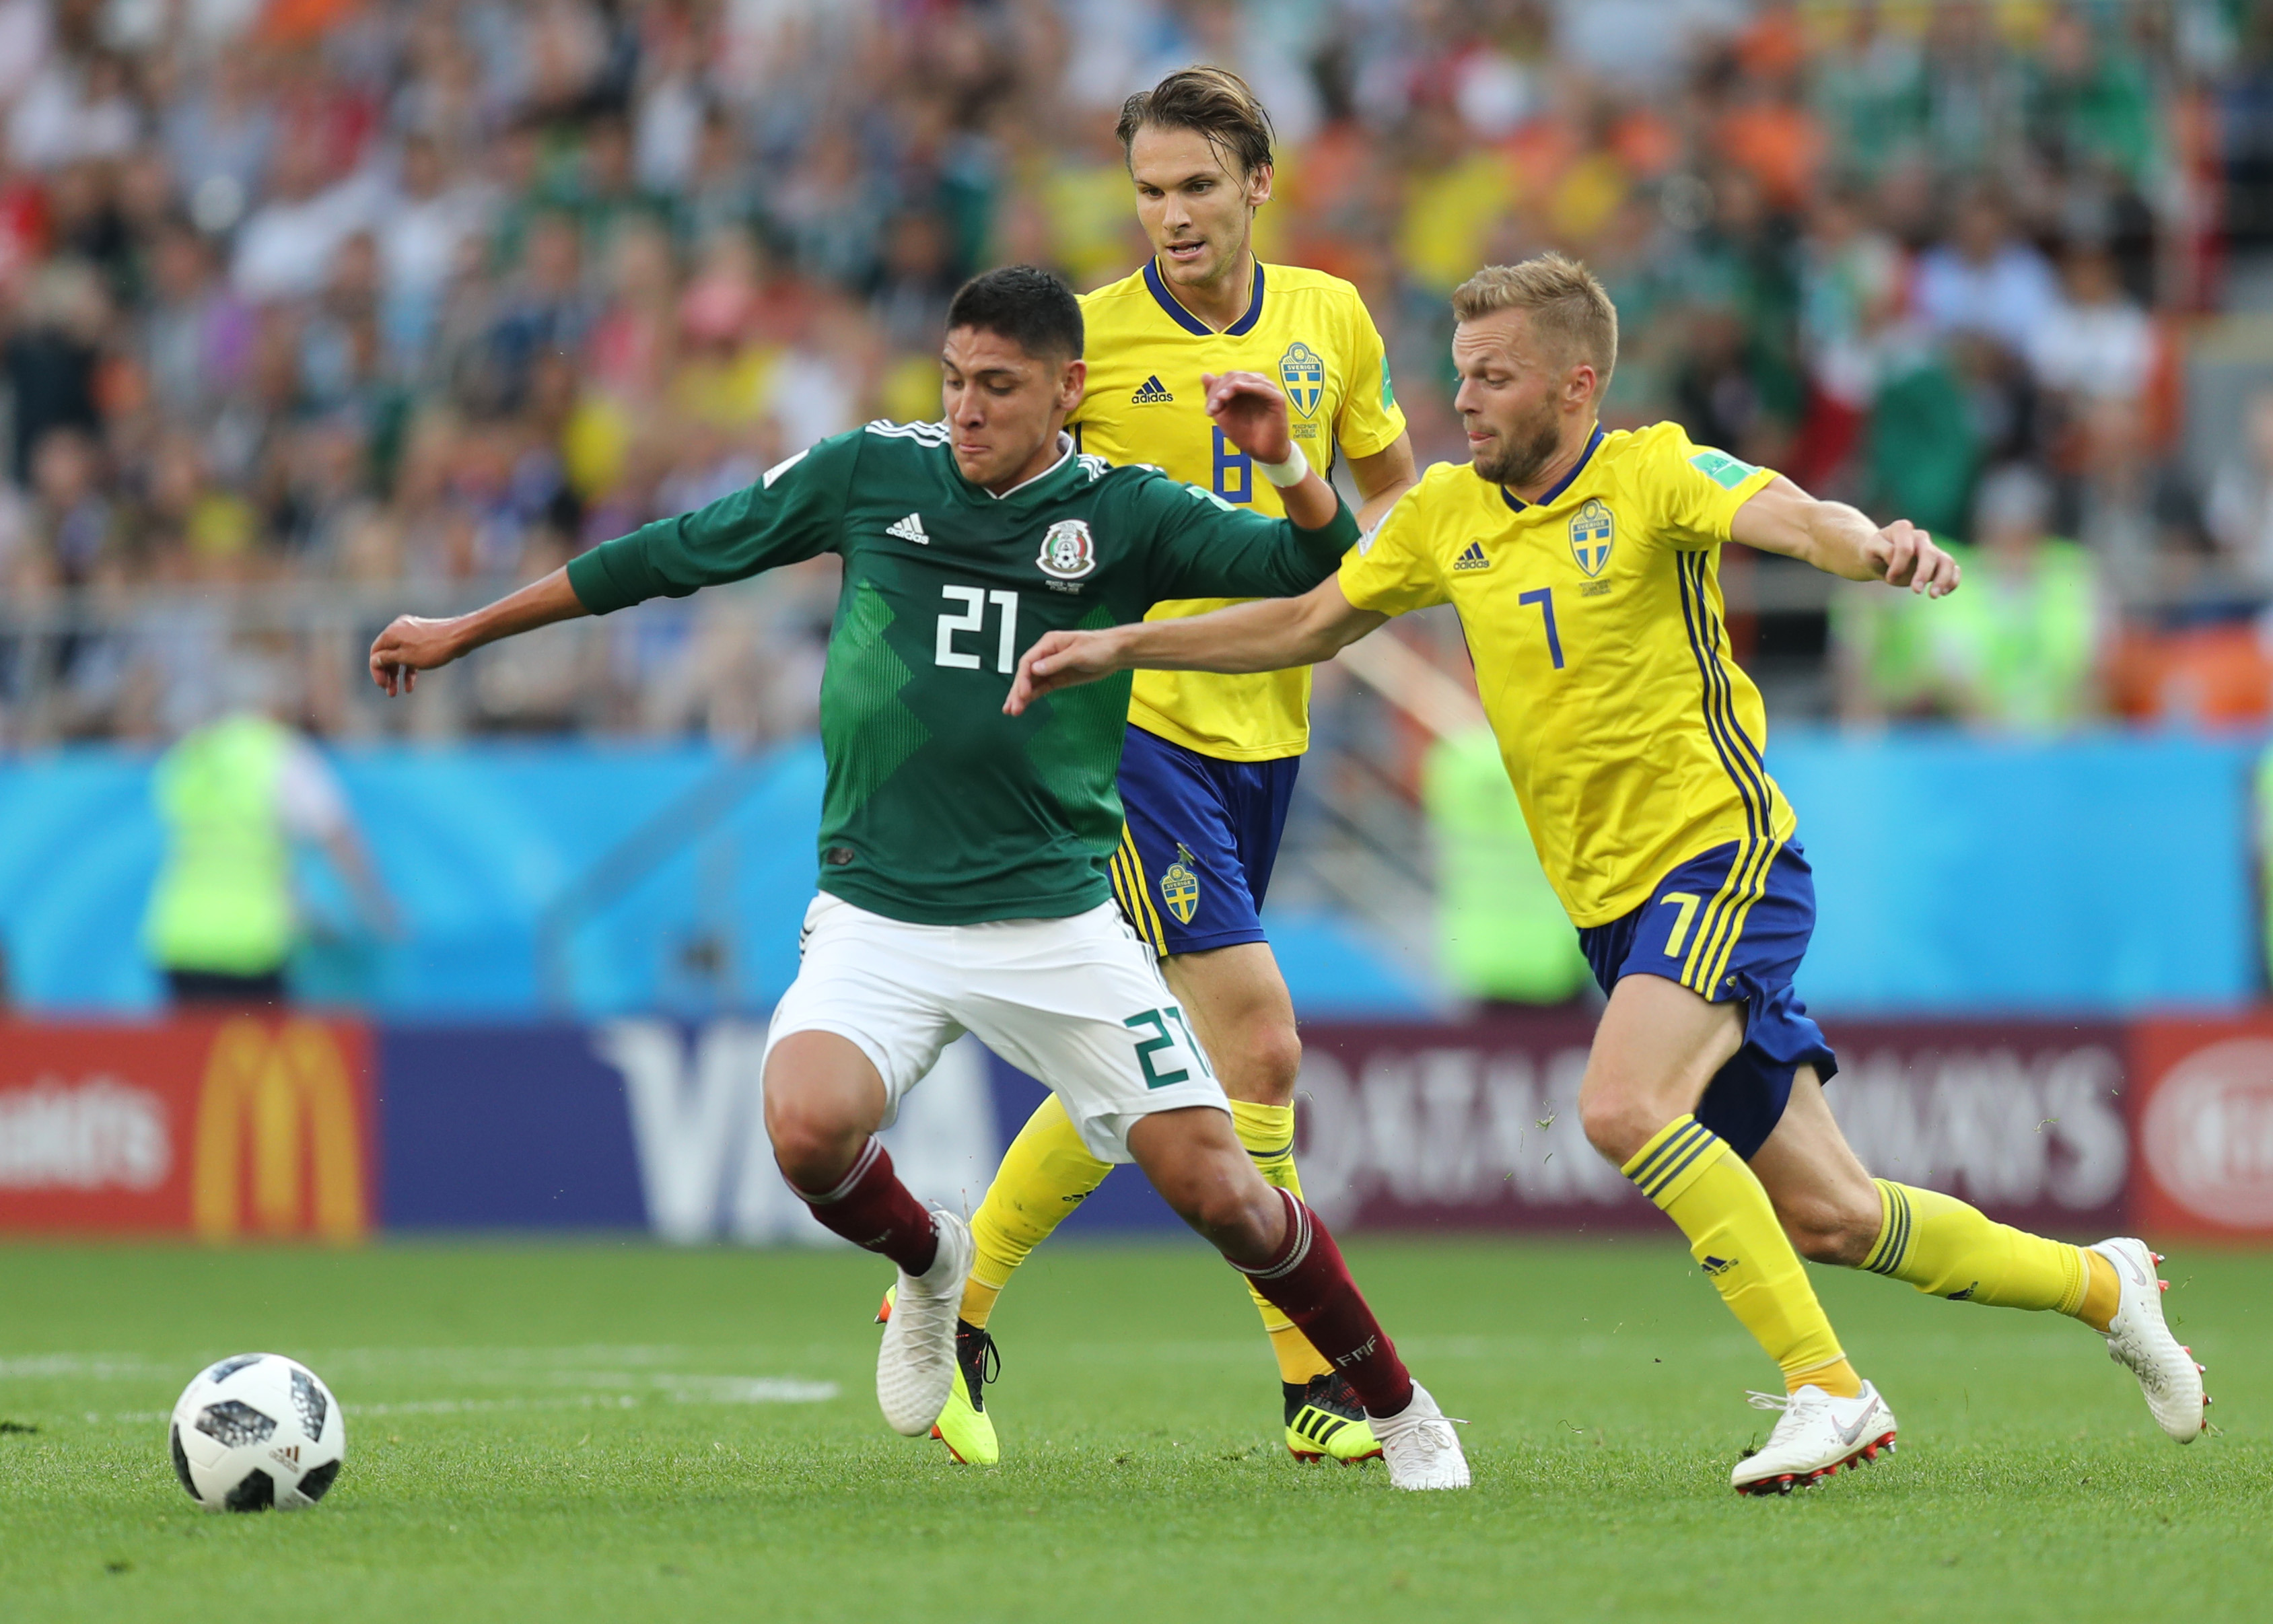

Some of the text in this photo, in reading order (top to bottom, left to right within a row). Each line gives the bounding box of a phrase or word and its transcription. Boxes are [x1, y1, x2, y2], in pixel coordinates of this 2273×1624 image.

[1131, 392, 1173, 404] adidas
[885, 526, 930, 545] adidas
[1577, 520, 1605, 530] SVERIGE
[1453, 559, 1490, 570] adidas
[935, 584, 1018, 674] 21
[1518, 587, 1564, 669] 7
[1166, 880, 1191, 888] SVERIGE
[1660, 892, 1701, 958] 7
[1122, 1006, 1210, 1090] 21
[1336, 1335, 1376, 1367] FMF
